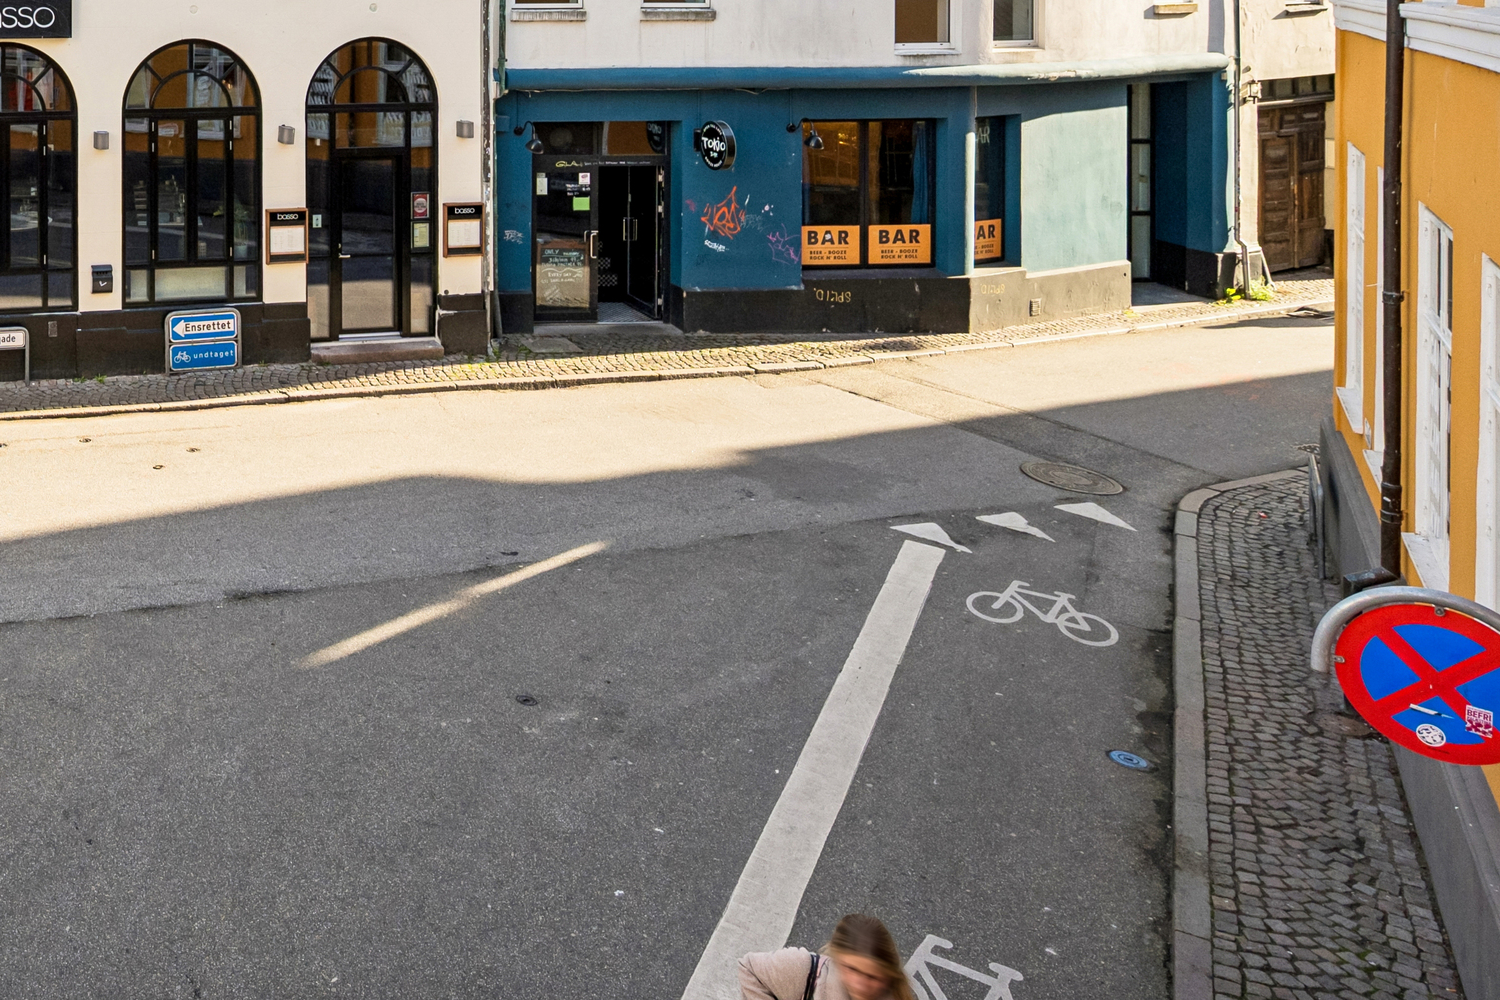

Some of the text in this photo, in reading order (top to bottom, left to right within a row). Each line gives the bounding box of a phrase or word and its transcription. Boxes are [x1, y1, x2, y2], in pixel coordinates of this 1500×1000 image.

[277, 213, 299, 221] basso
[807, 230, 850, 246] BAR
[878, 229, 921, 244] BAR
[976, 224, 996, 240] AR
[184, 320, 231, 333] Ensrettet
[193, 349, 234, 359] undtaget
[1467, 709, 1492, 721] BEFRI
